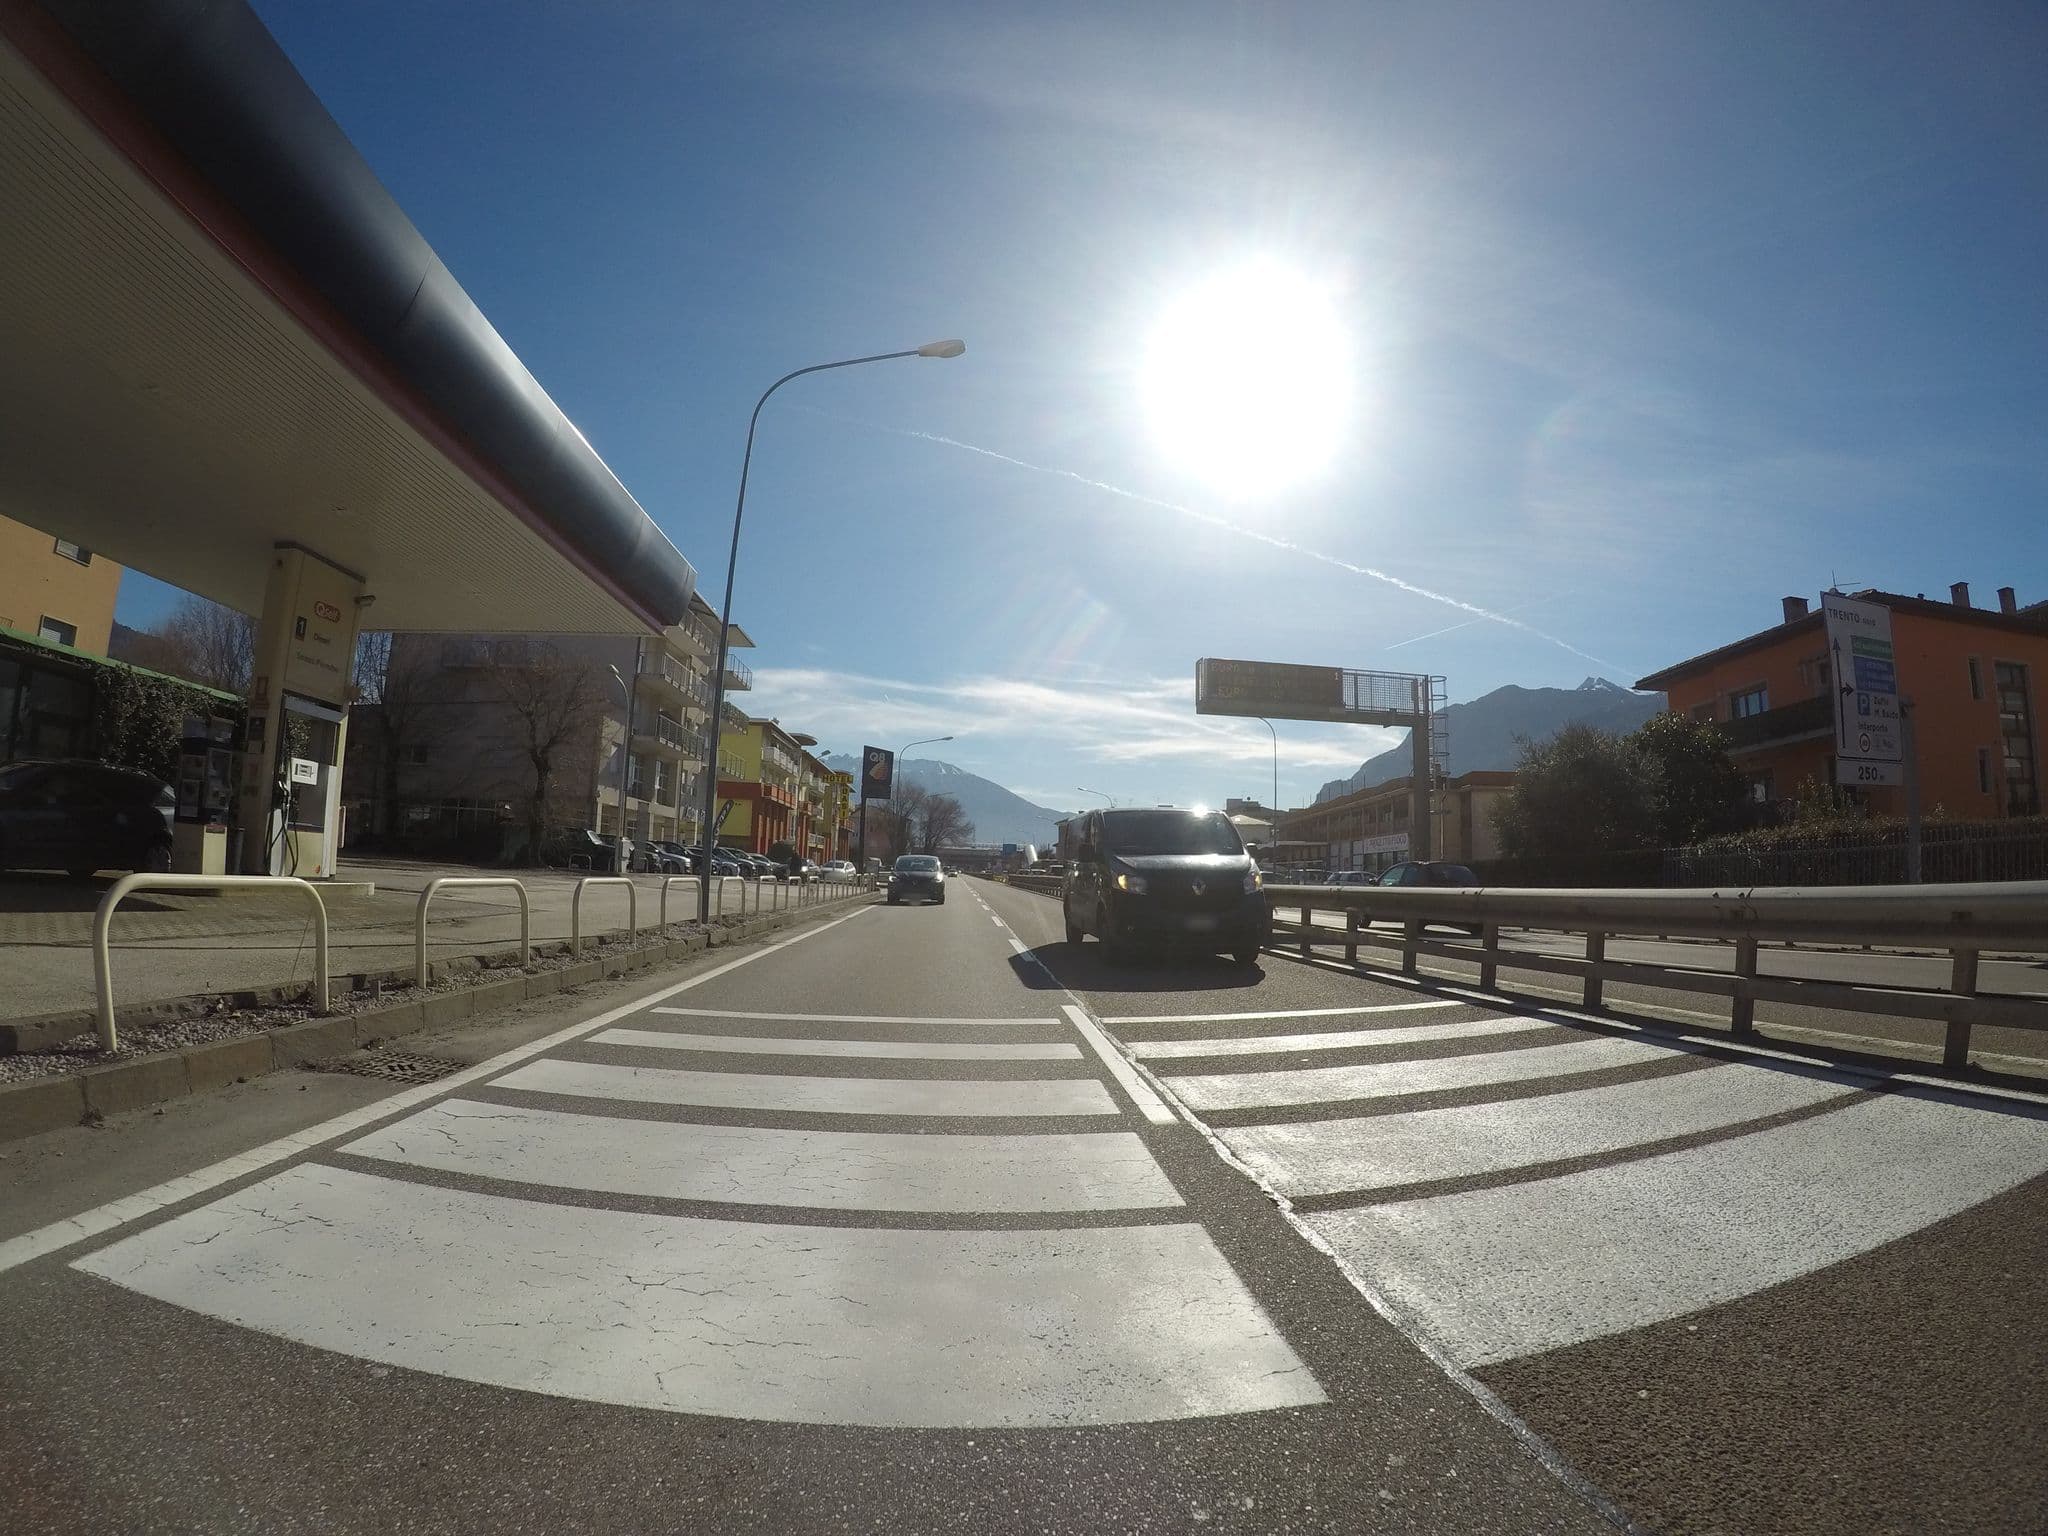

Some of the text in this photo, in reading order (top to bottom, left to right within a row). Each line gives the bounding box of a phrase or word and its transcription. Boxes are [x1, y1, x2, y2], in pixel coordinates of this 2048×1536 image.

[1827, 608, 1860, 623] TRENTO
[870, 752, 885, 762] Q8
[822, 775, 851, 783] HOTEL
[1858, 766, 1878, 781] 250
